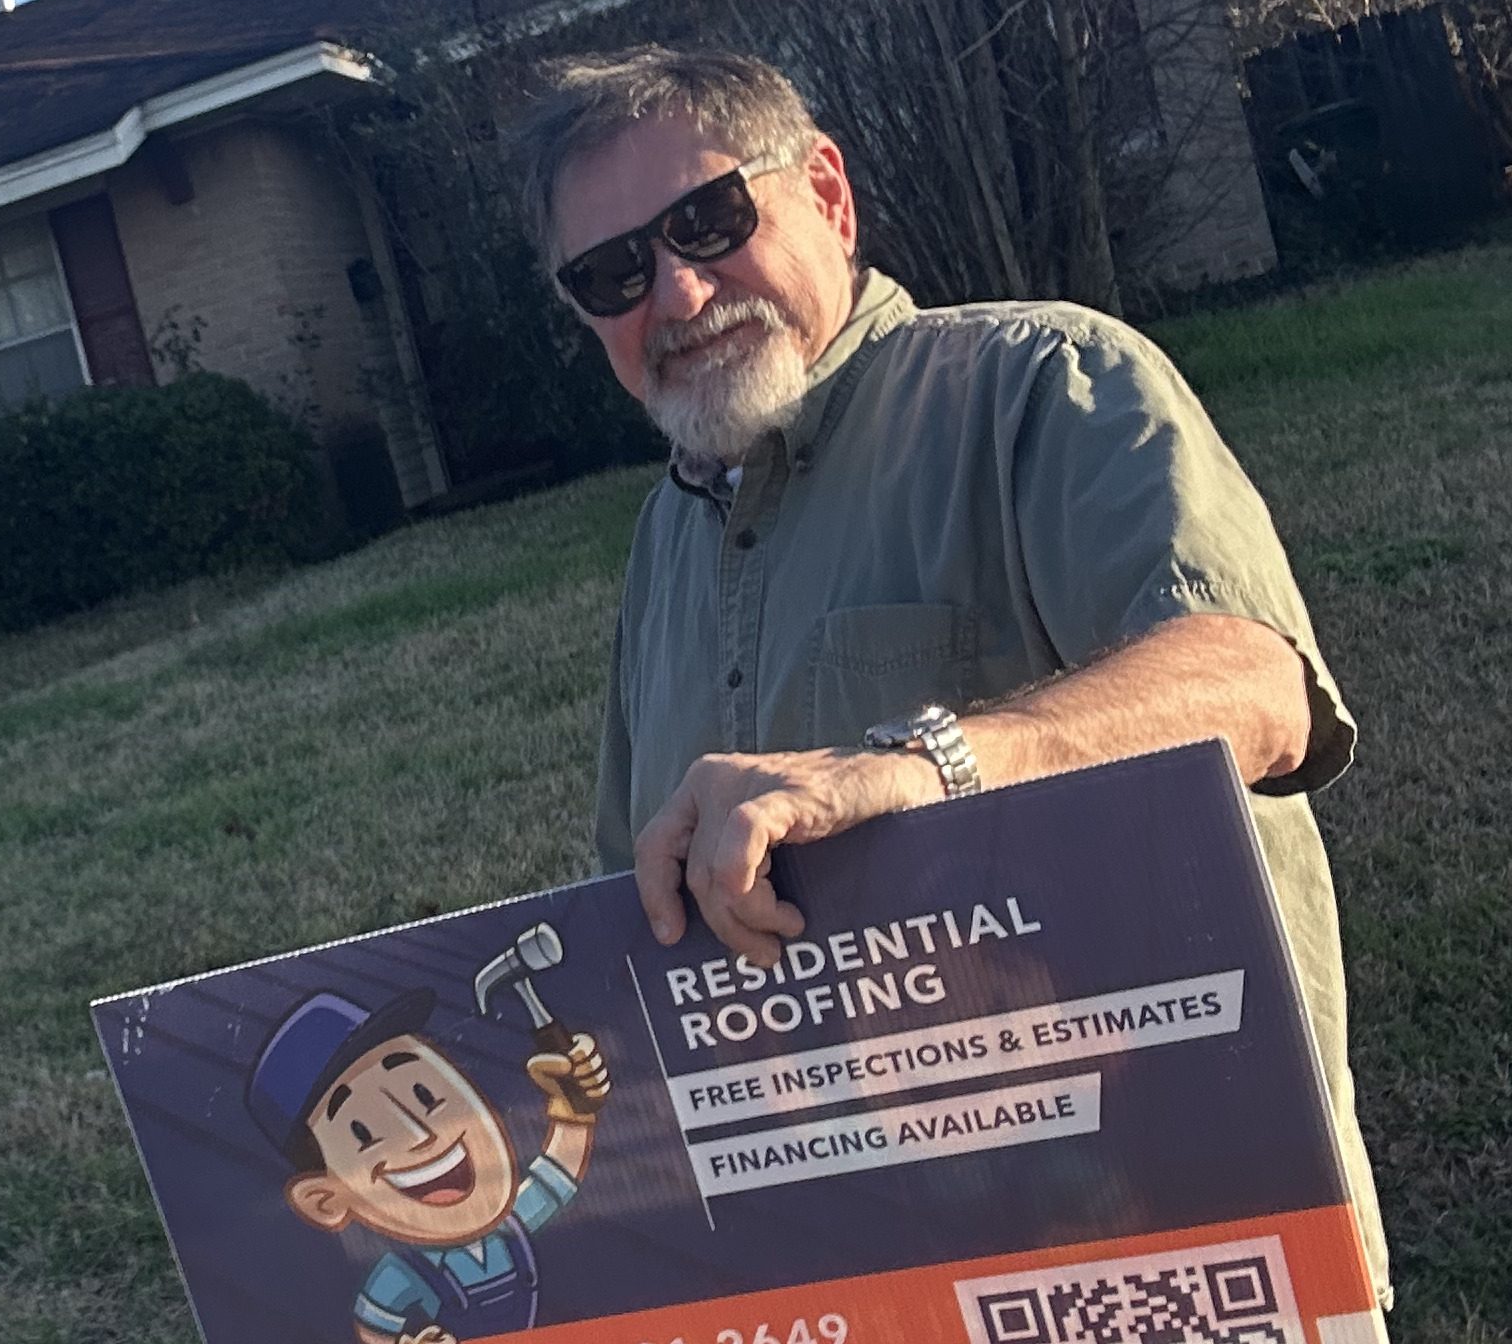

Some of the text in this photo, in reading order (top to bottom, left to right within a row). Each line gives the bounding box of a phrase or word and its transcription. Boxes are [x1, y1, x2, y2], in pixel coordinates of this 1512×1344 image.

[666, 897, 1042, 1006] RESIDENTIAL
[679, 963, 947, 1051] ROOFING
[689, 992, 1222, 1113] FREE INSPECTIONS & ESTIMATES
[710, 1094, 1075, 1178] FINANCING AVAILABLE
